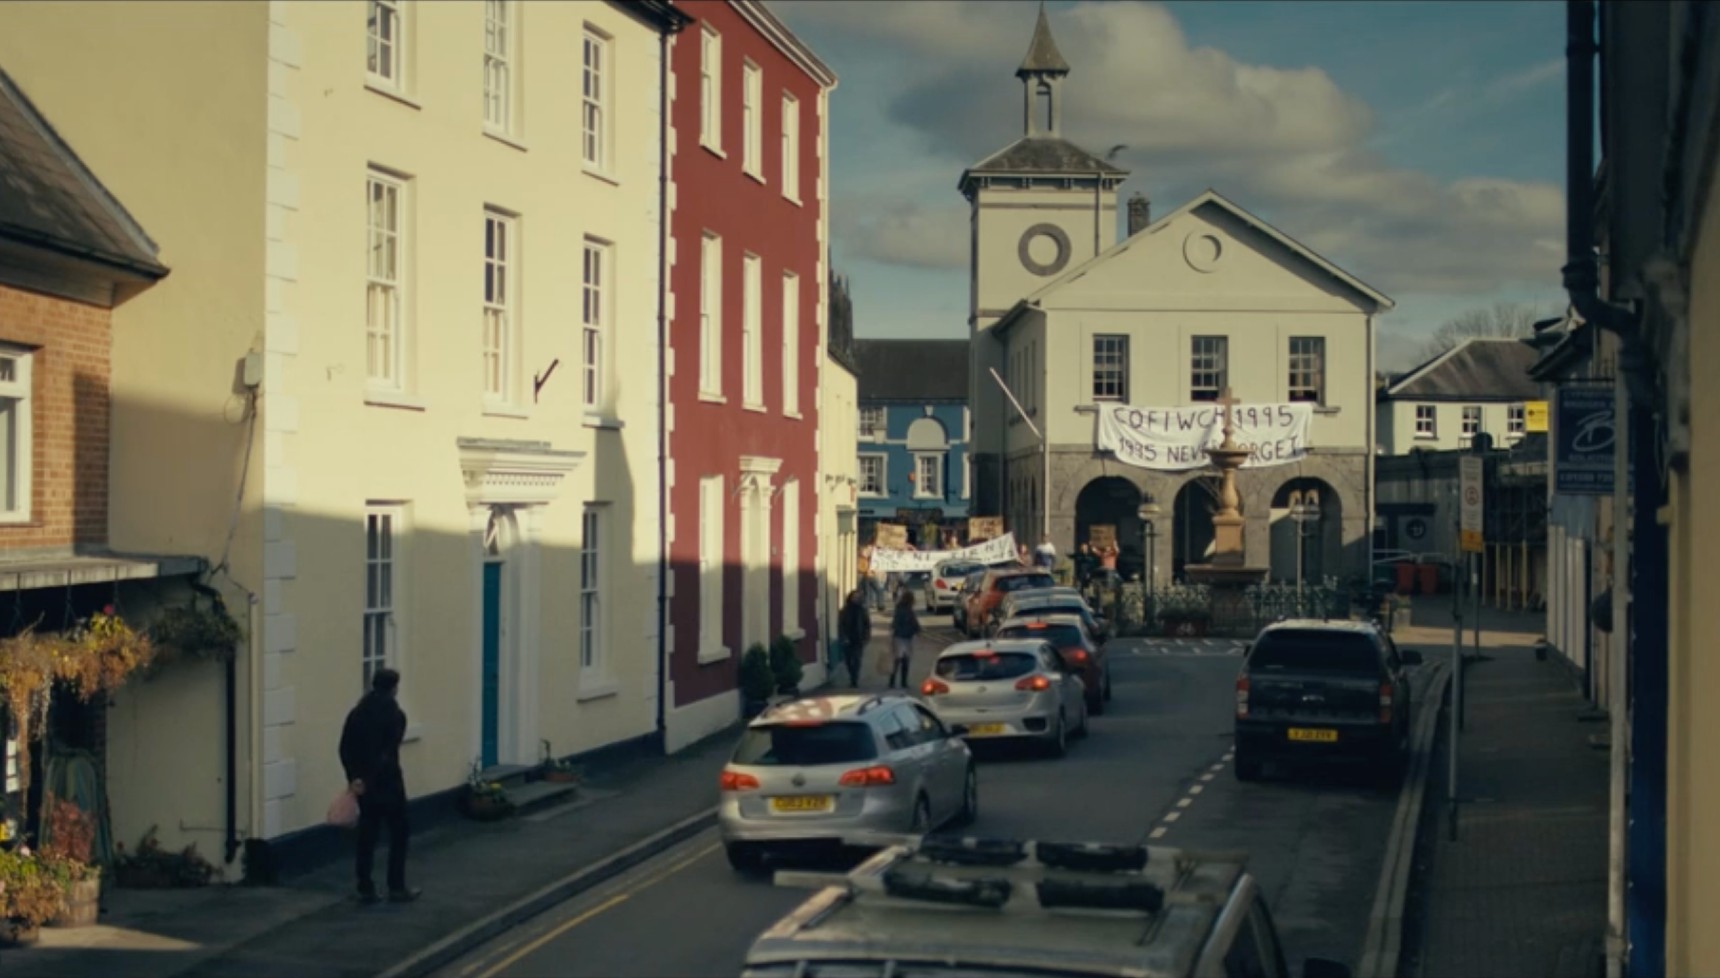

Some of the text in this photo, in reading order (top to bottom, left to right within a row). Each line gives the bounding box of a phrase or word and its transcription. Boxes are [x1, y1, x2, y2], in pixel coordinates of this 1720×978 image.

[1113, 404, 1295, 433] COFIWCH 1995
[1237, 434, 1298, 463] RGET
